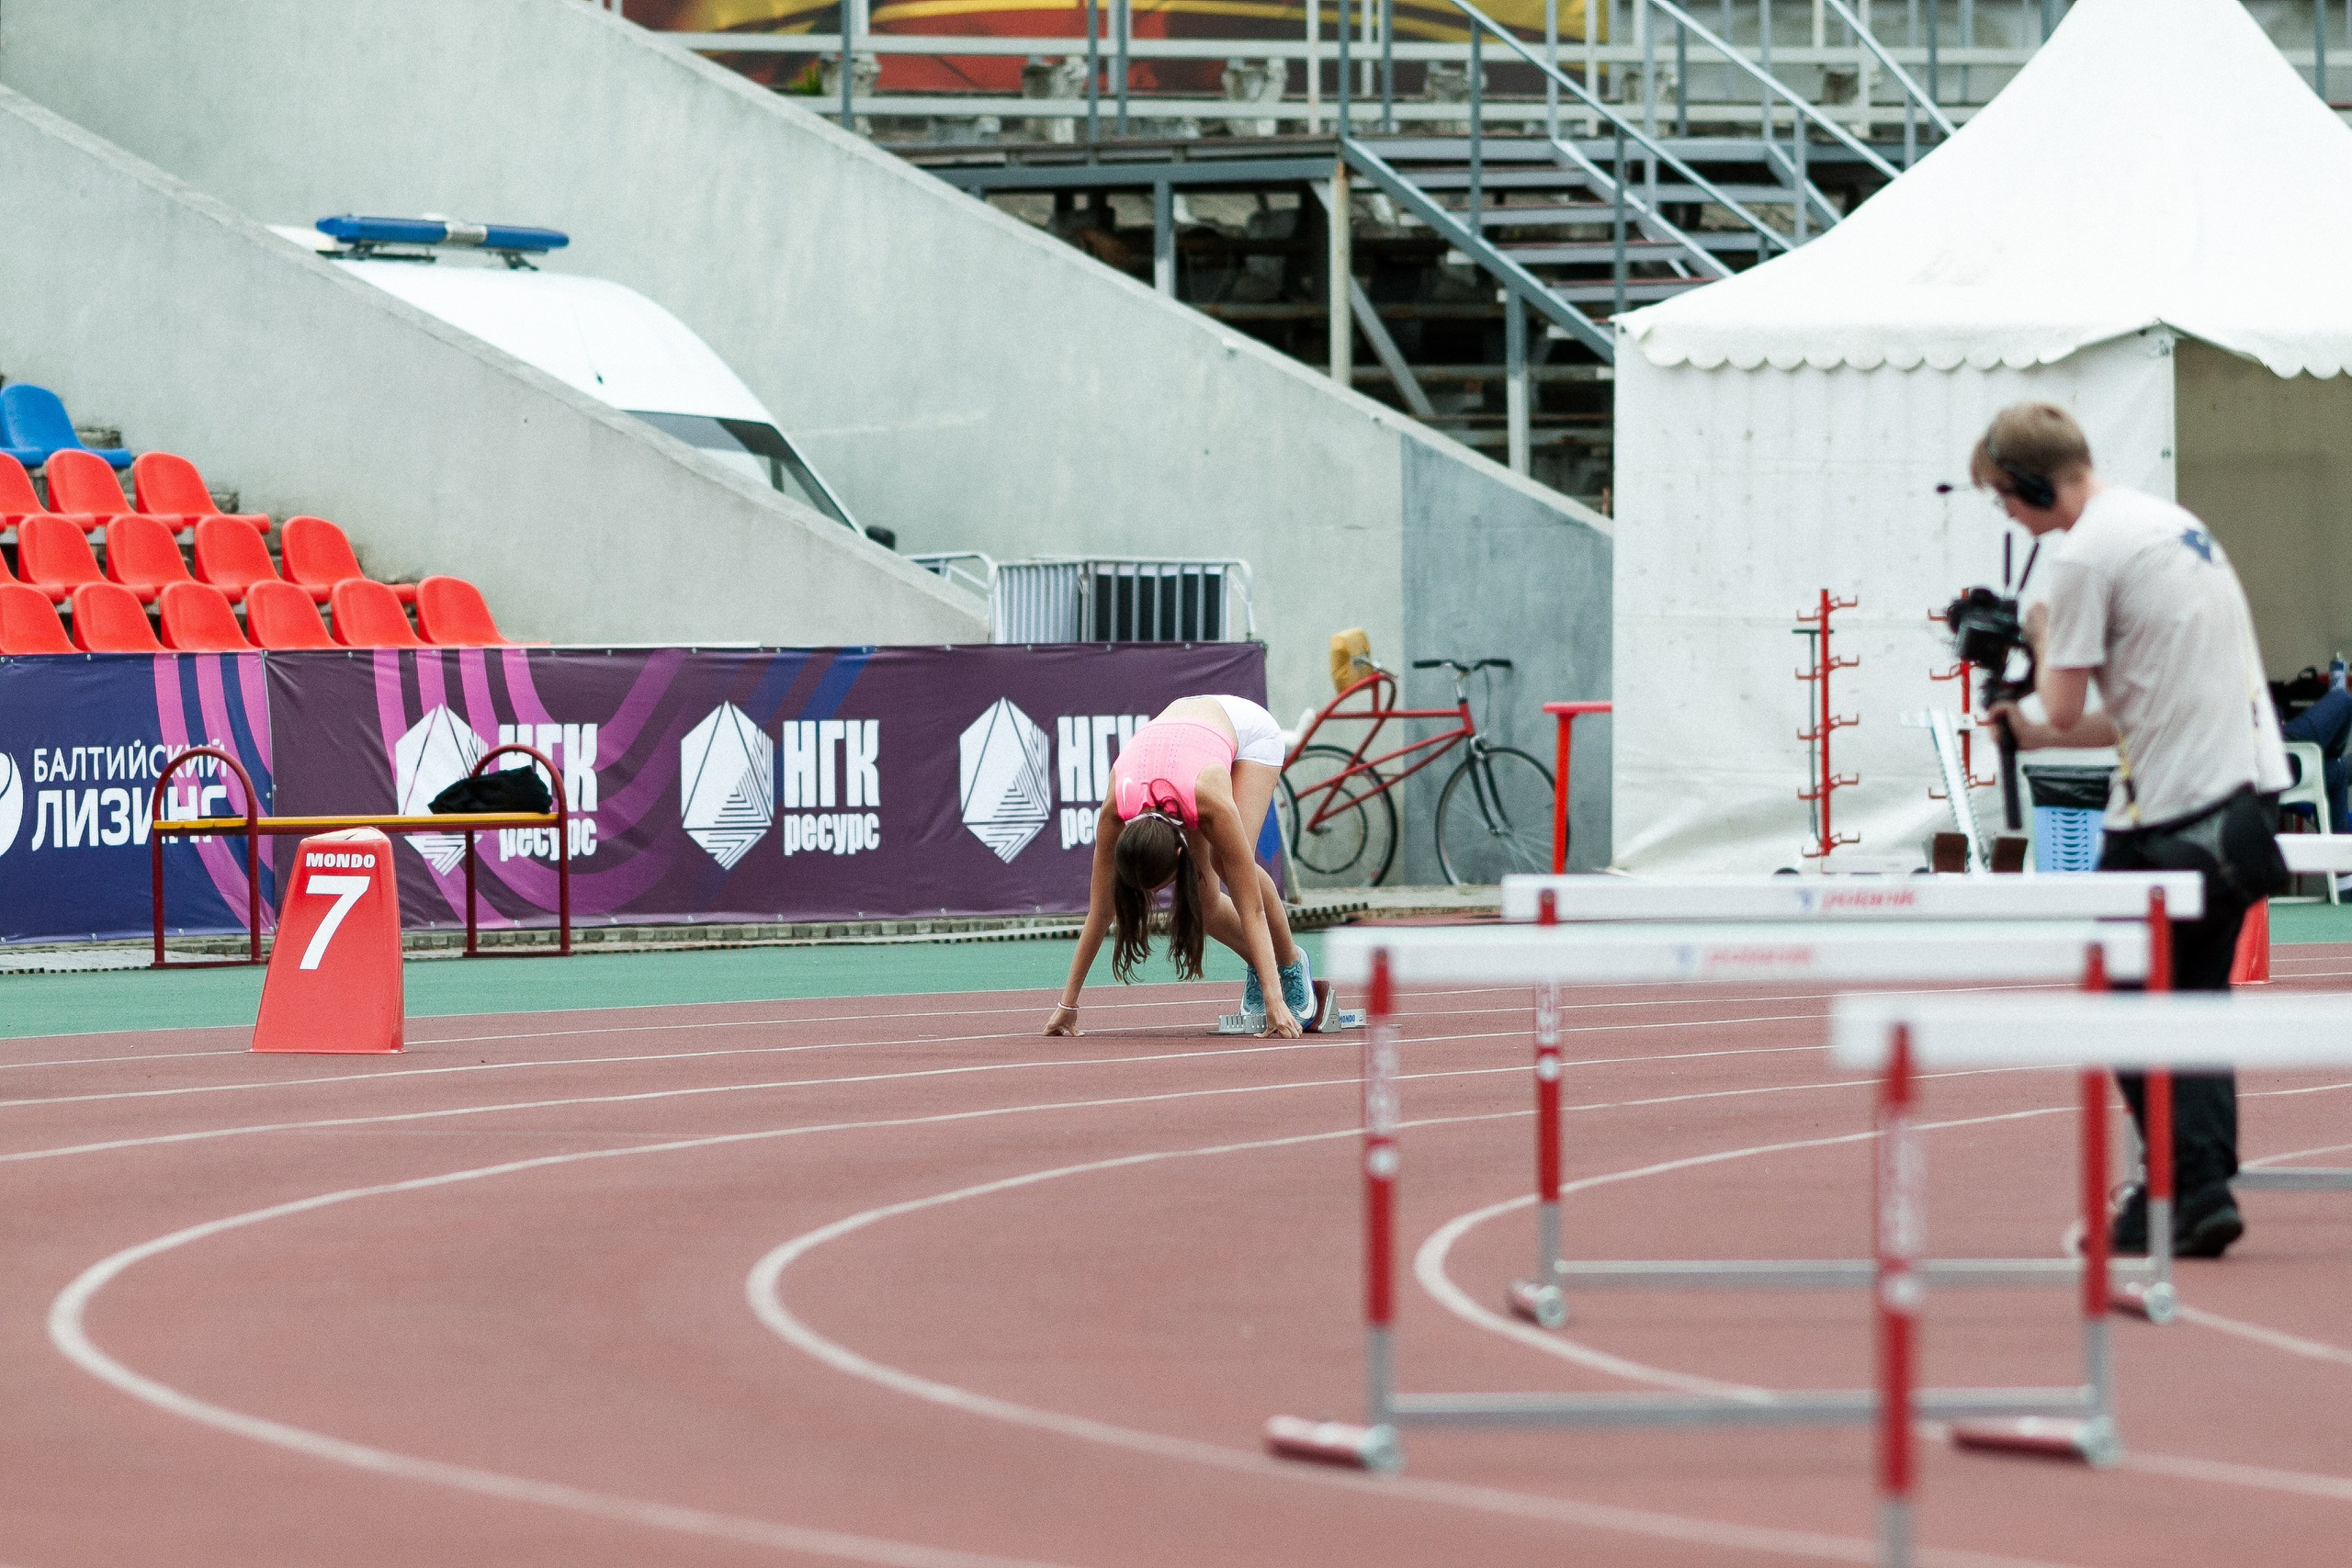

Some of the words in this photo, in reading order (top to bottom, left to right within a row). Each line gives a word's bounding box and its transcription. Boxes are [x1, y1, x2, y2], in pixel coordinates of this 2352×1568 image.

[34, 739, 228, 782] БАЛТИЙСКИЙ
[784, 719, 879, 807] НГК
[32, 785, 227, 851] ЛИЗИНГ
[784, 813, 879, 855] ресурс
[306, 852, 375, 868] MONDO
[299, 875, 370, 970] 7
